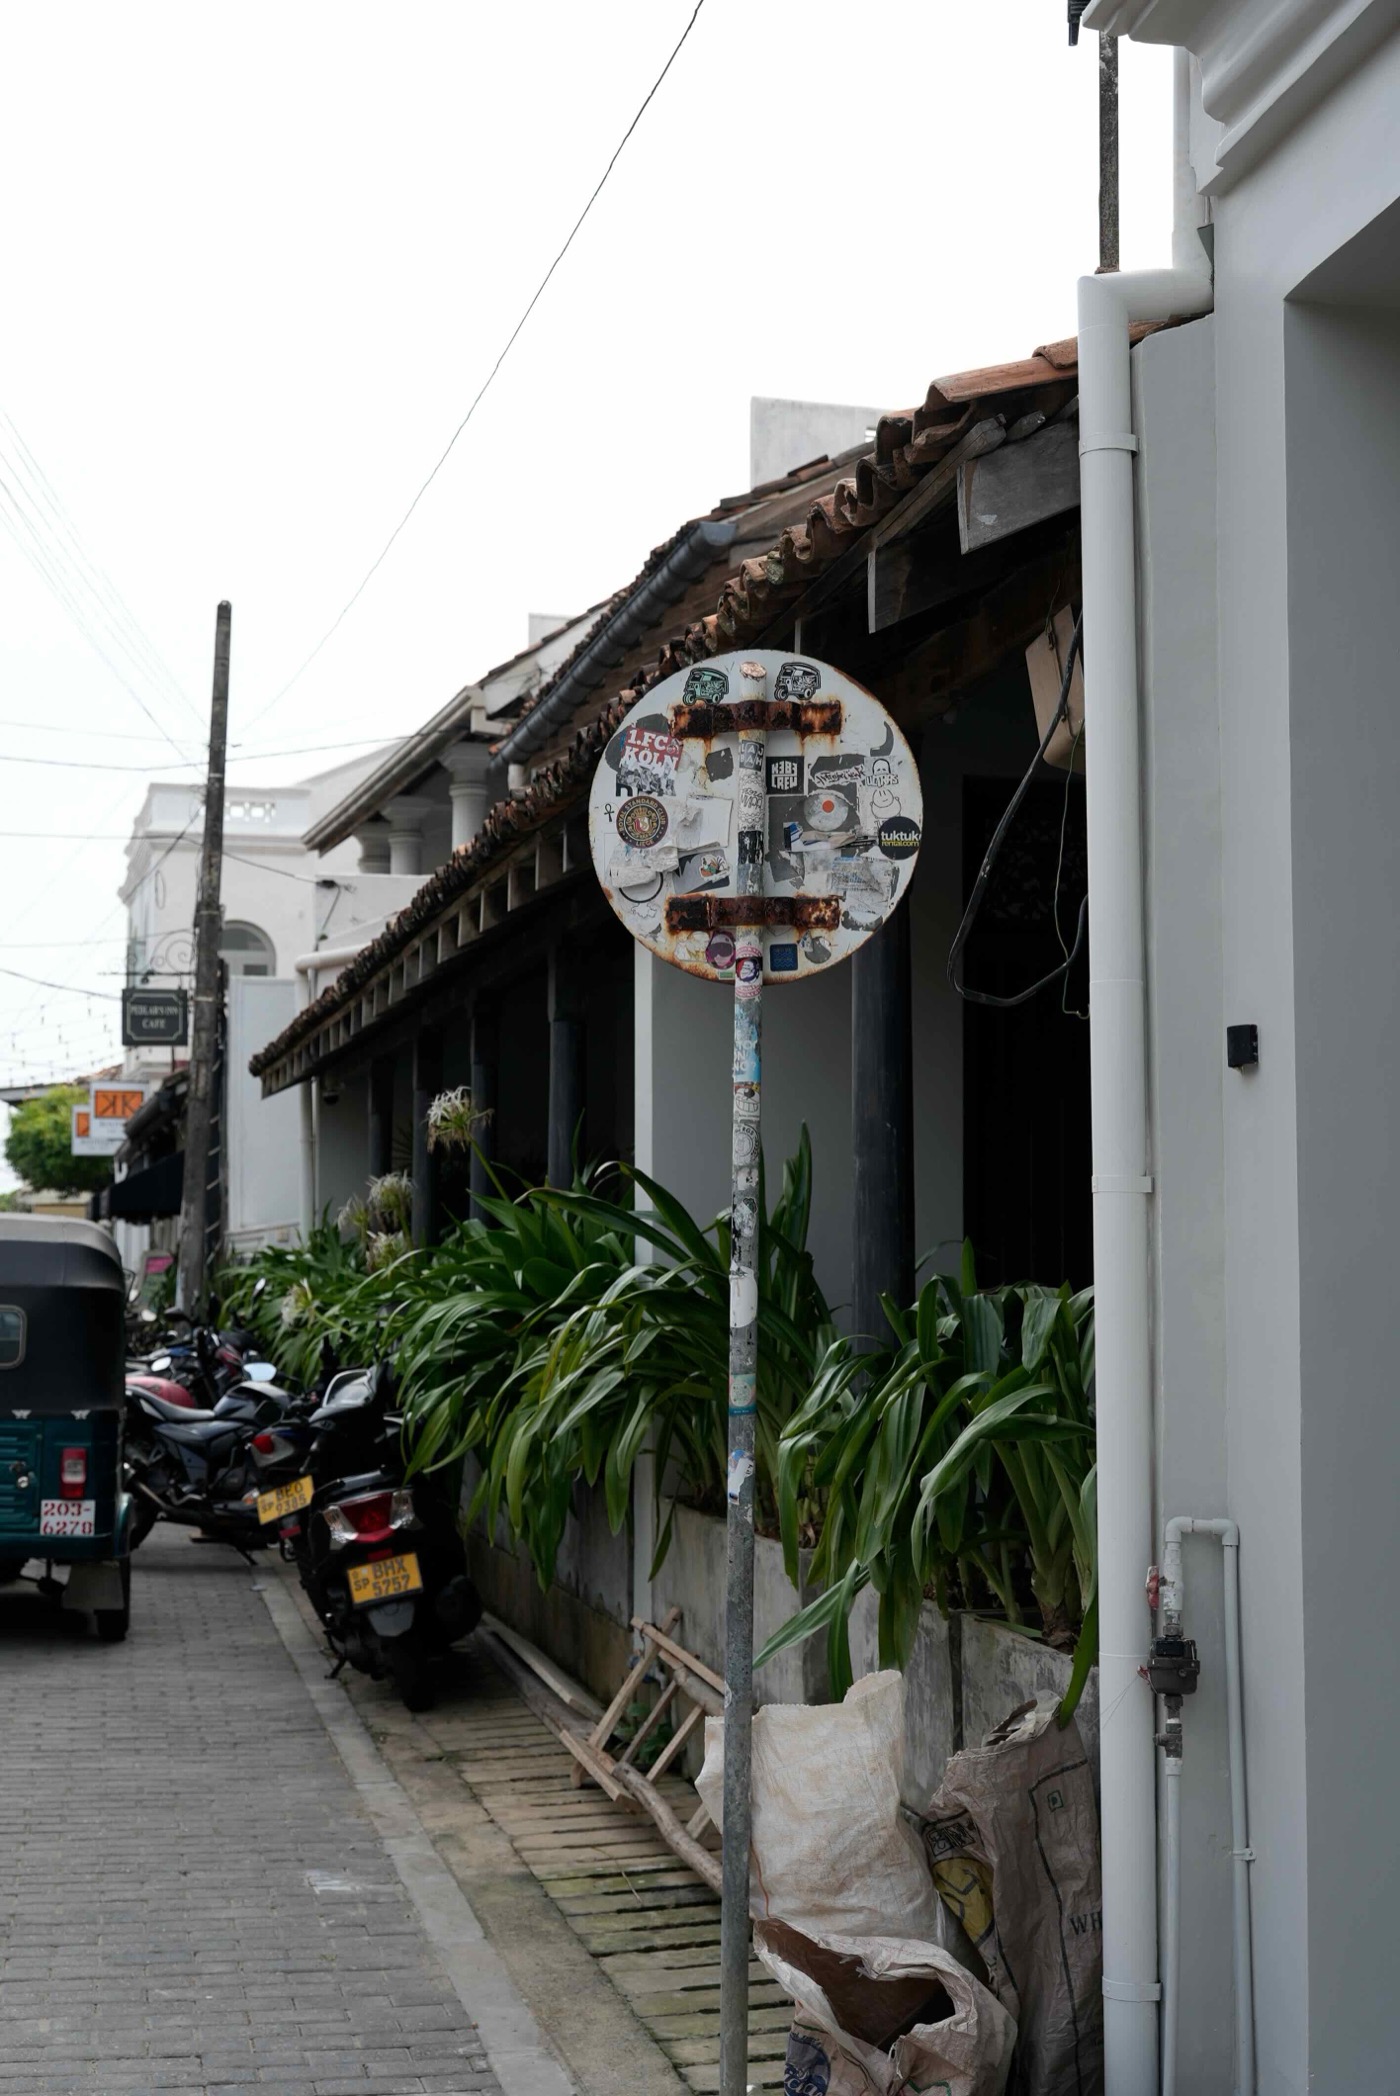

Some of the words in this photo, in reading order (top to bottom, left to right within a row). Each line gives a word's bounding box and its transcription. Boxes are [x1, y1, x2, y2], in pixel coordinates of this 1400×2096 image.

[628, 729, 669, 751] 1.FC
[620, 745, 679, 780] KÖLN
[771, 776, 798, 790] CREW
[618, 810, 627, 832] ROYAL
[625, 798, 659, 810] STANDARD
[657, 807, 667, 825] CLUB
[881, 830, 918, 841] tuktuk
[43, 1520, 92, 1536] 6278
[371, 1556, 407, 1579] BHX
[354, 1577, 370, 1592] SP
[372, 1573, 410, 1598] 5757
